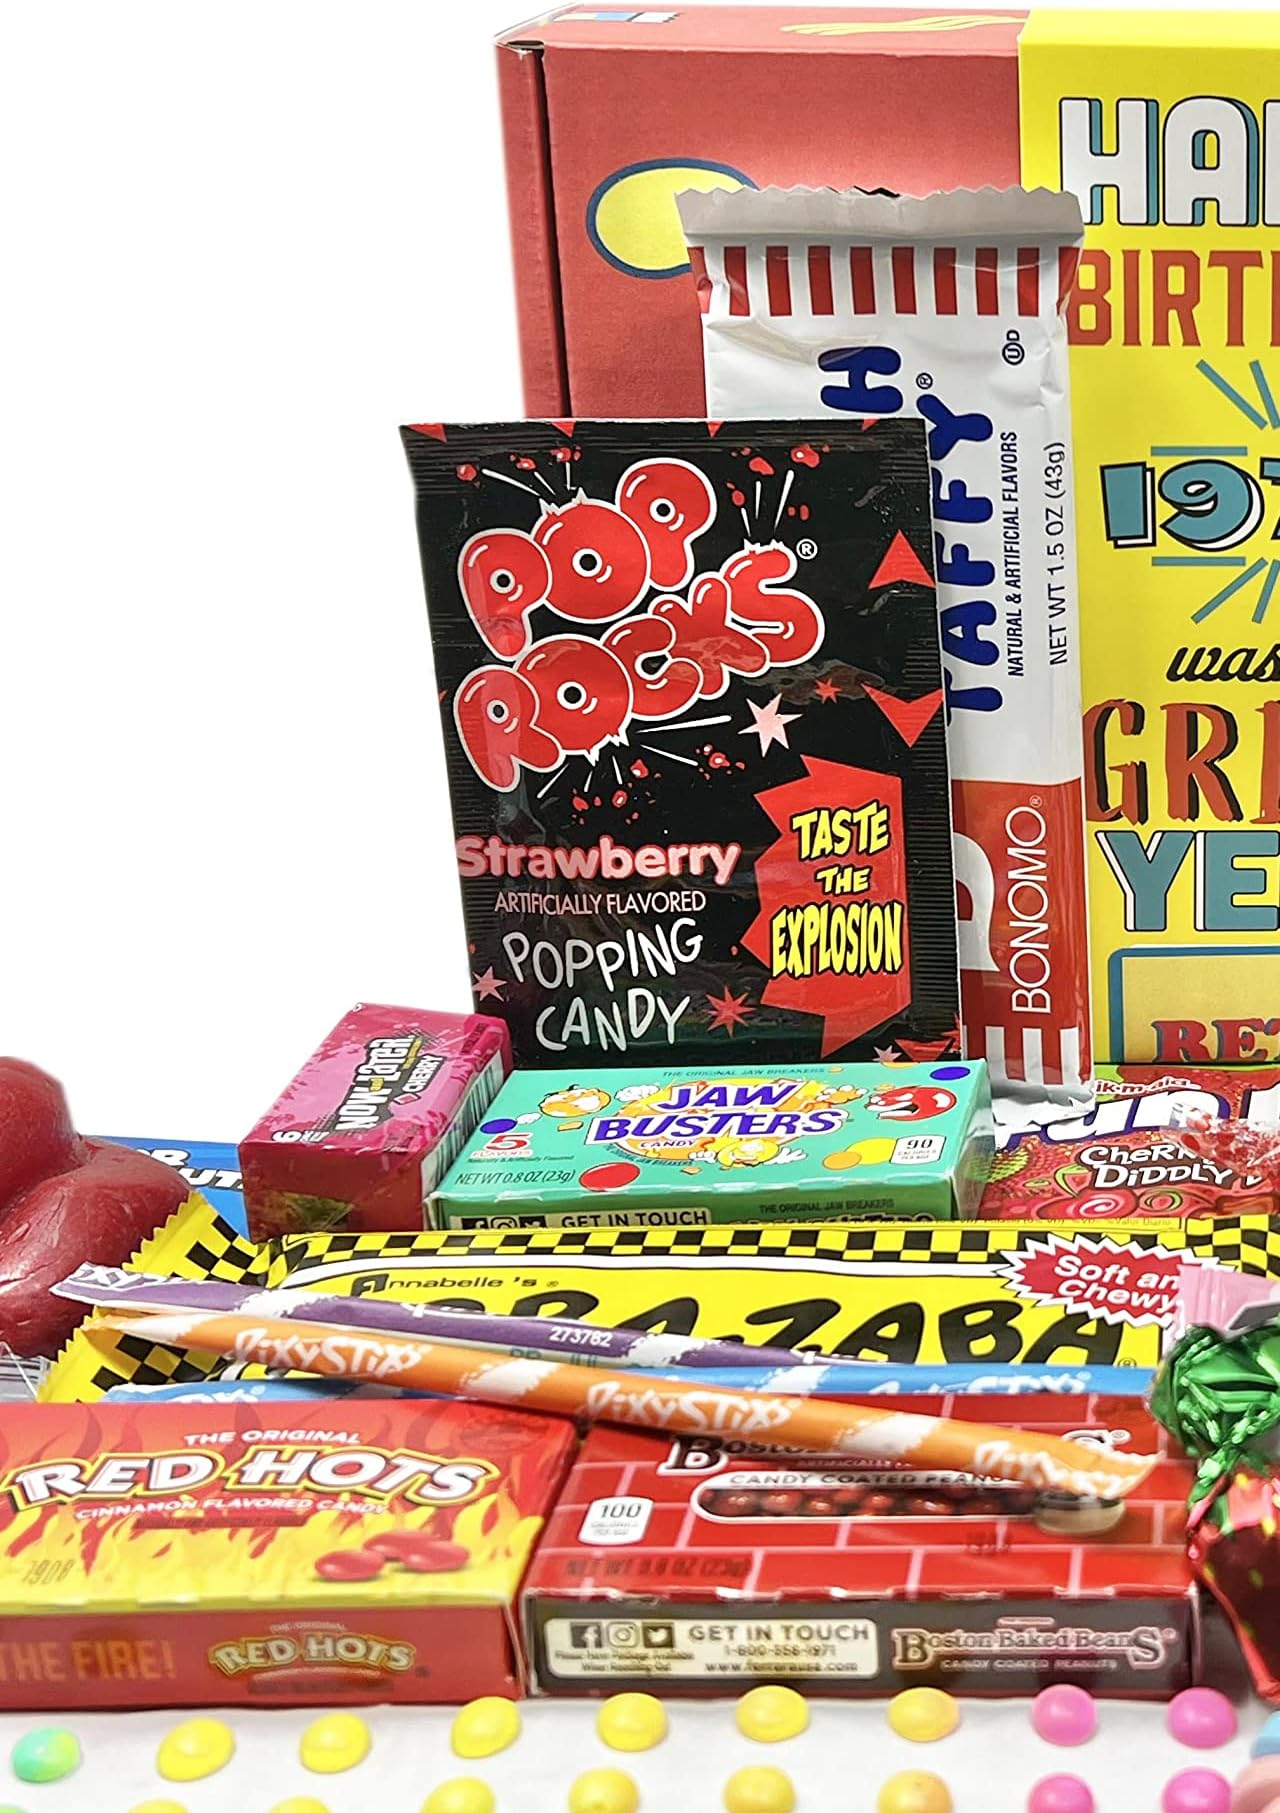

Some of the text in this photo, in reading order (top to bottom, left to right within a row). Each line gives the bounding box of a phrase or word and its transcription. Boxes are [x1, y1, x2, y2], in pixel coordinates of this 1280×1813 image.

[458, 457, 717, 663] POP
[1000, 431, 1024, 677] NATURAL & ARTIFICIAL FLAVORS
[1044, 442, 1067, 665] NET WT 1.5 OZ (43g)
[453, 539, 826, 794] ROCKS
[792, 800, 890, 862] TASTE
[456, 834, 743, 886] Strawberry
[816, 866, 871, 896] THE
[495, 890, 707, 915] ARTIFICIALLY FLAVORED
[1005, 805, 1052, 1014] BONOMO
[502, 917, 705, 992] POPPING
[771, 901, 904, 979] EXPLOSION
[535, 987, 691, 1052] CANDY
[654, 1083, 801, 1112] JAW
[485, 1133, 530, 1151] 5
[593, 1111, 844, 1142] BUSTERS
[640, 1139, 697, 1148] CANDY
[906, 1138, 934, 1150] 90
[455, 1172, 482, 1185] NET
[524, 1170, 544, 1183] OZ
[561, 1209, 709, 1228] GET IN TOUCH
[1054, 1254, 1180, 1290] Soft an
[1058, 1280, 1181, 1313] Chewy
[184, 1429, 361, 1446] THE ORIGINAL
[17, 1449, 488, 1504] RED HOTS
[730, 1473, 915, 1486] CANDY COATED
[75, 1497, 389, 1521] CINNAMON FLAVORED CANDY
[599, 1502, 642, 1520] 100
[688, 1623, 870, 1642] GET IN TOUCH
[891, 1628, 997, 1670] Boston
[998, 1627, 1073, 1650] Baked
[72, 1640, 176, 1681] FIRE!
[215, 1634, 413, 1672] RED HOTS
